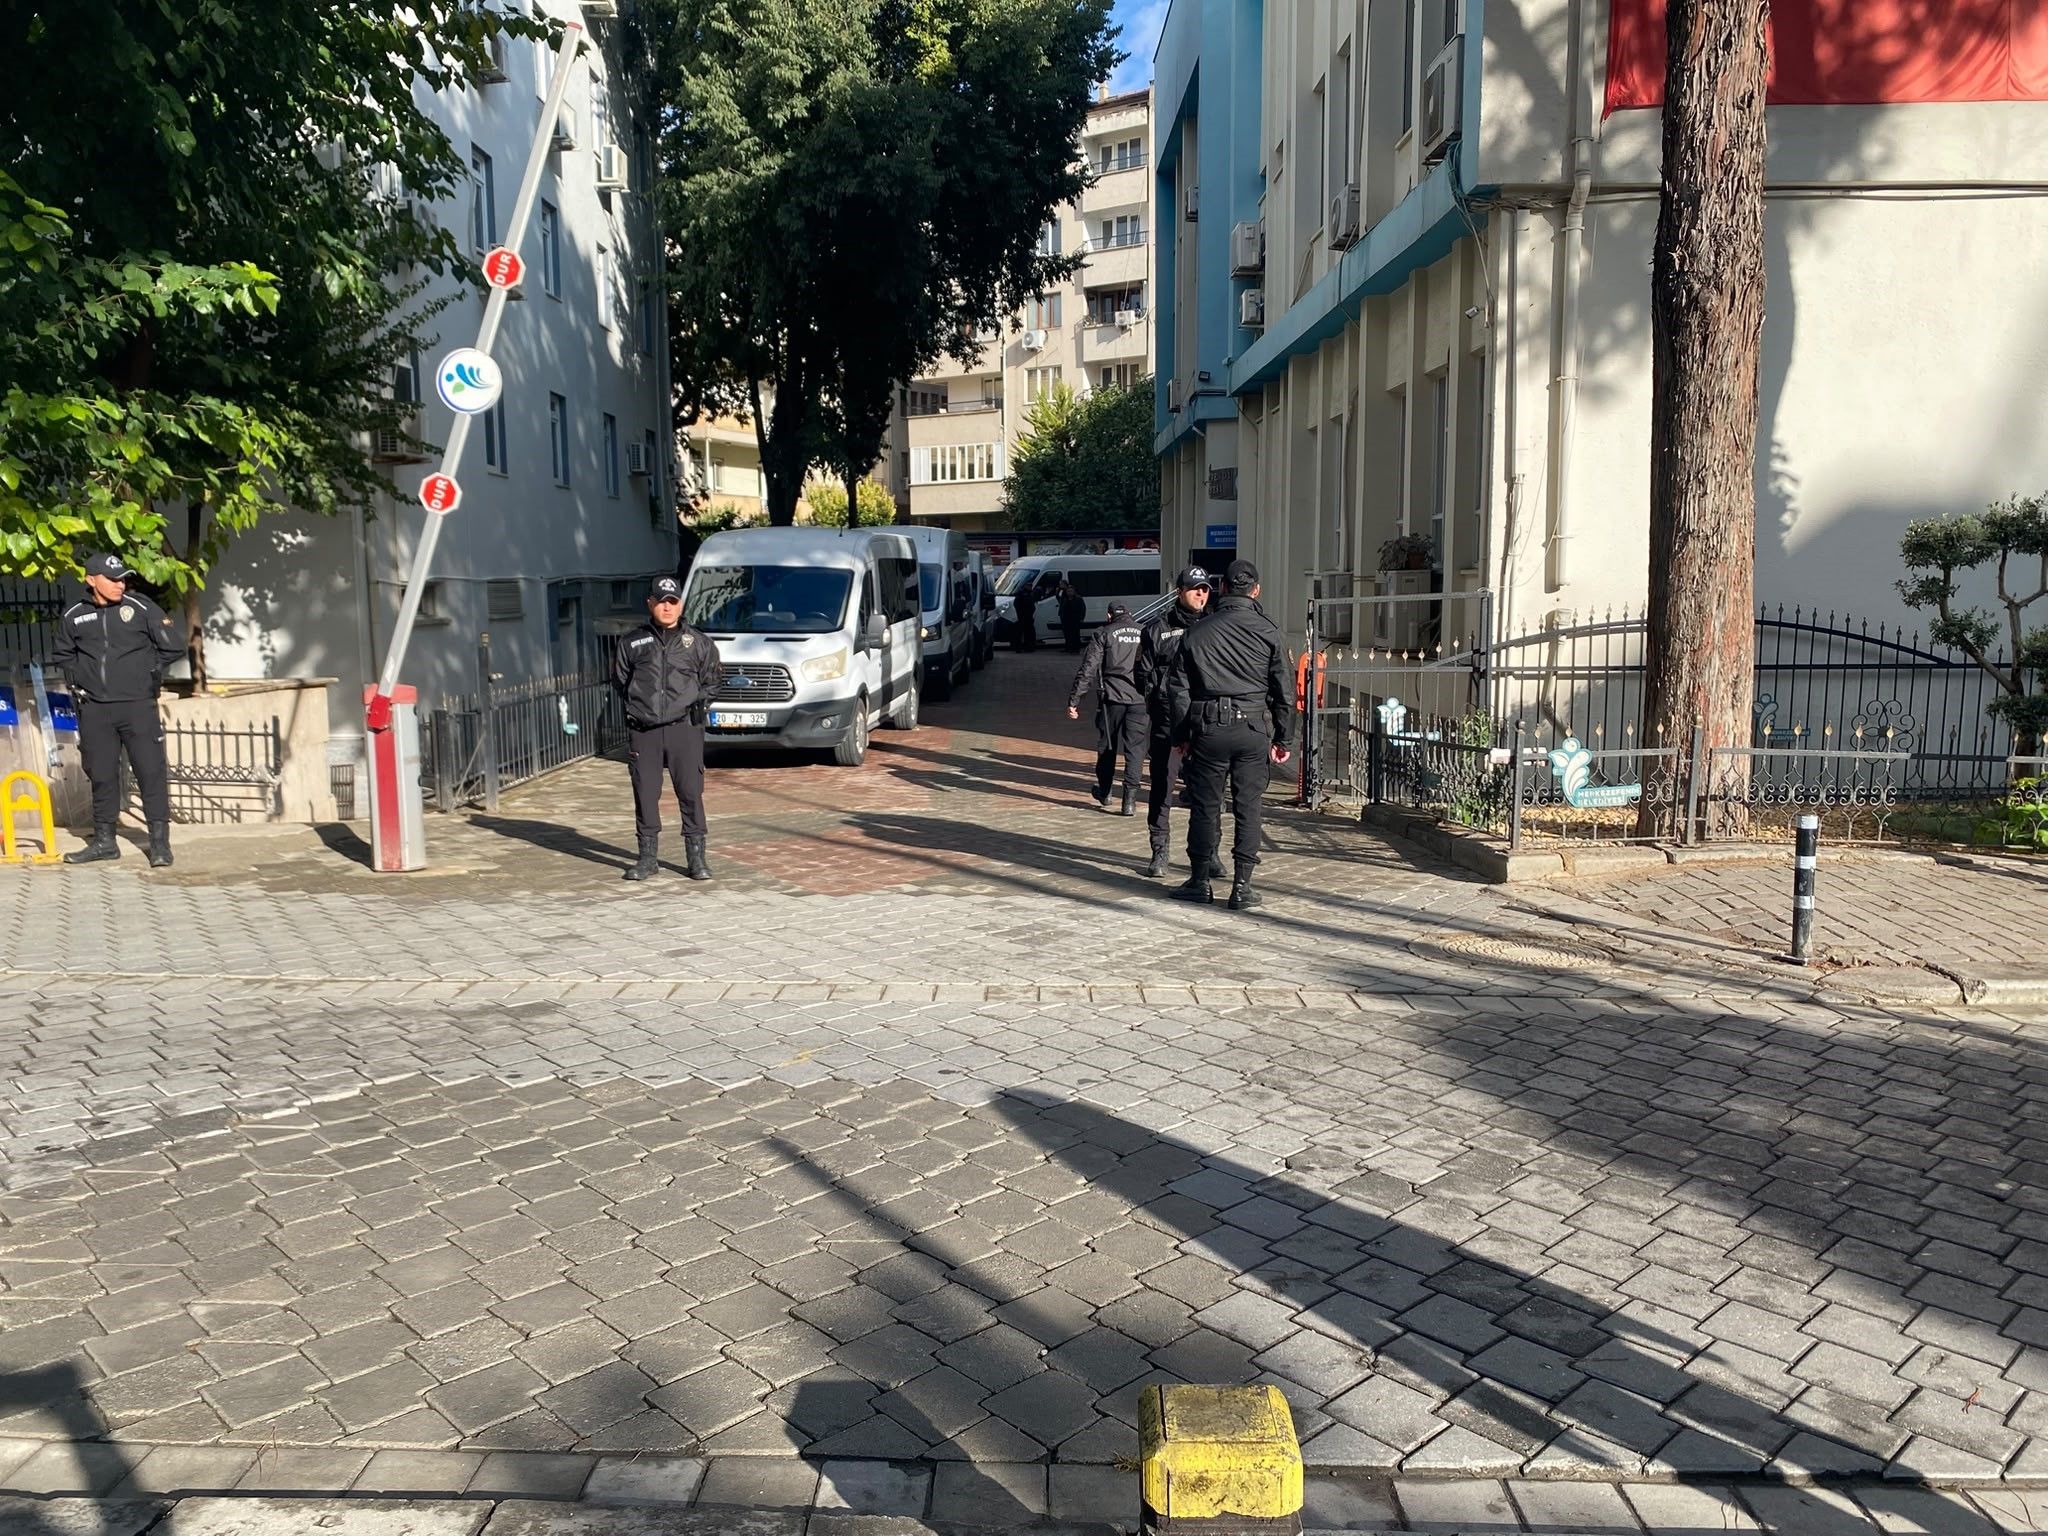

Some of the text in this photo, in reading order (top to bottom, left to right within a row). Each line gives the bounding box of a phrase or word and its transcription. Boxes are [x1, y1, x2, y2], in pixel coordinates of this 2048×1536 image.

[494, 253, 512, 285] DUR
[430, 479, 449, 509] DUR
[717, 713, 726, 723] 20
[751, 713, 765, 723] 325
